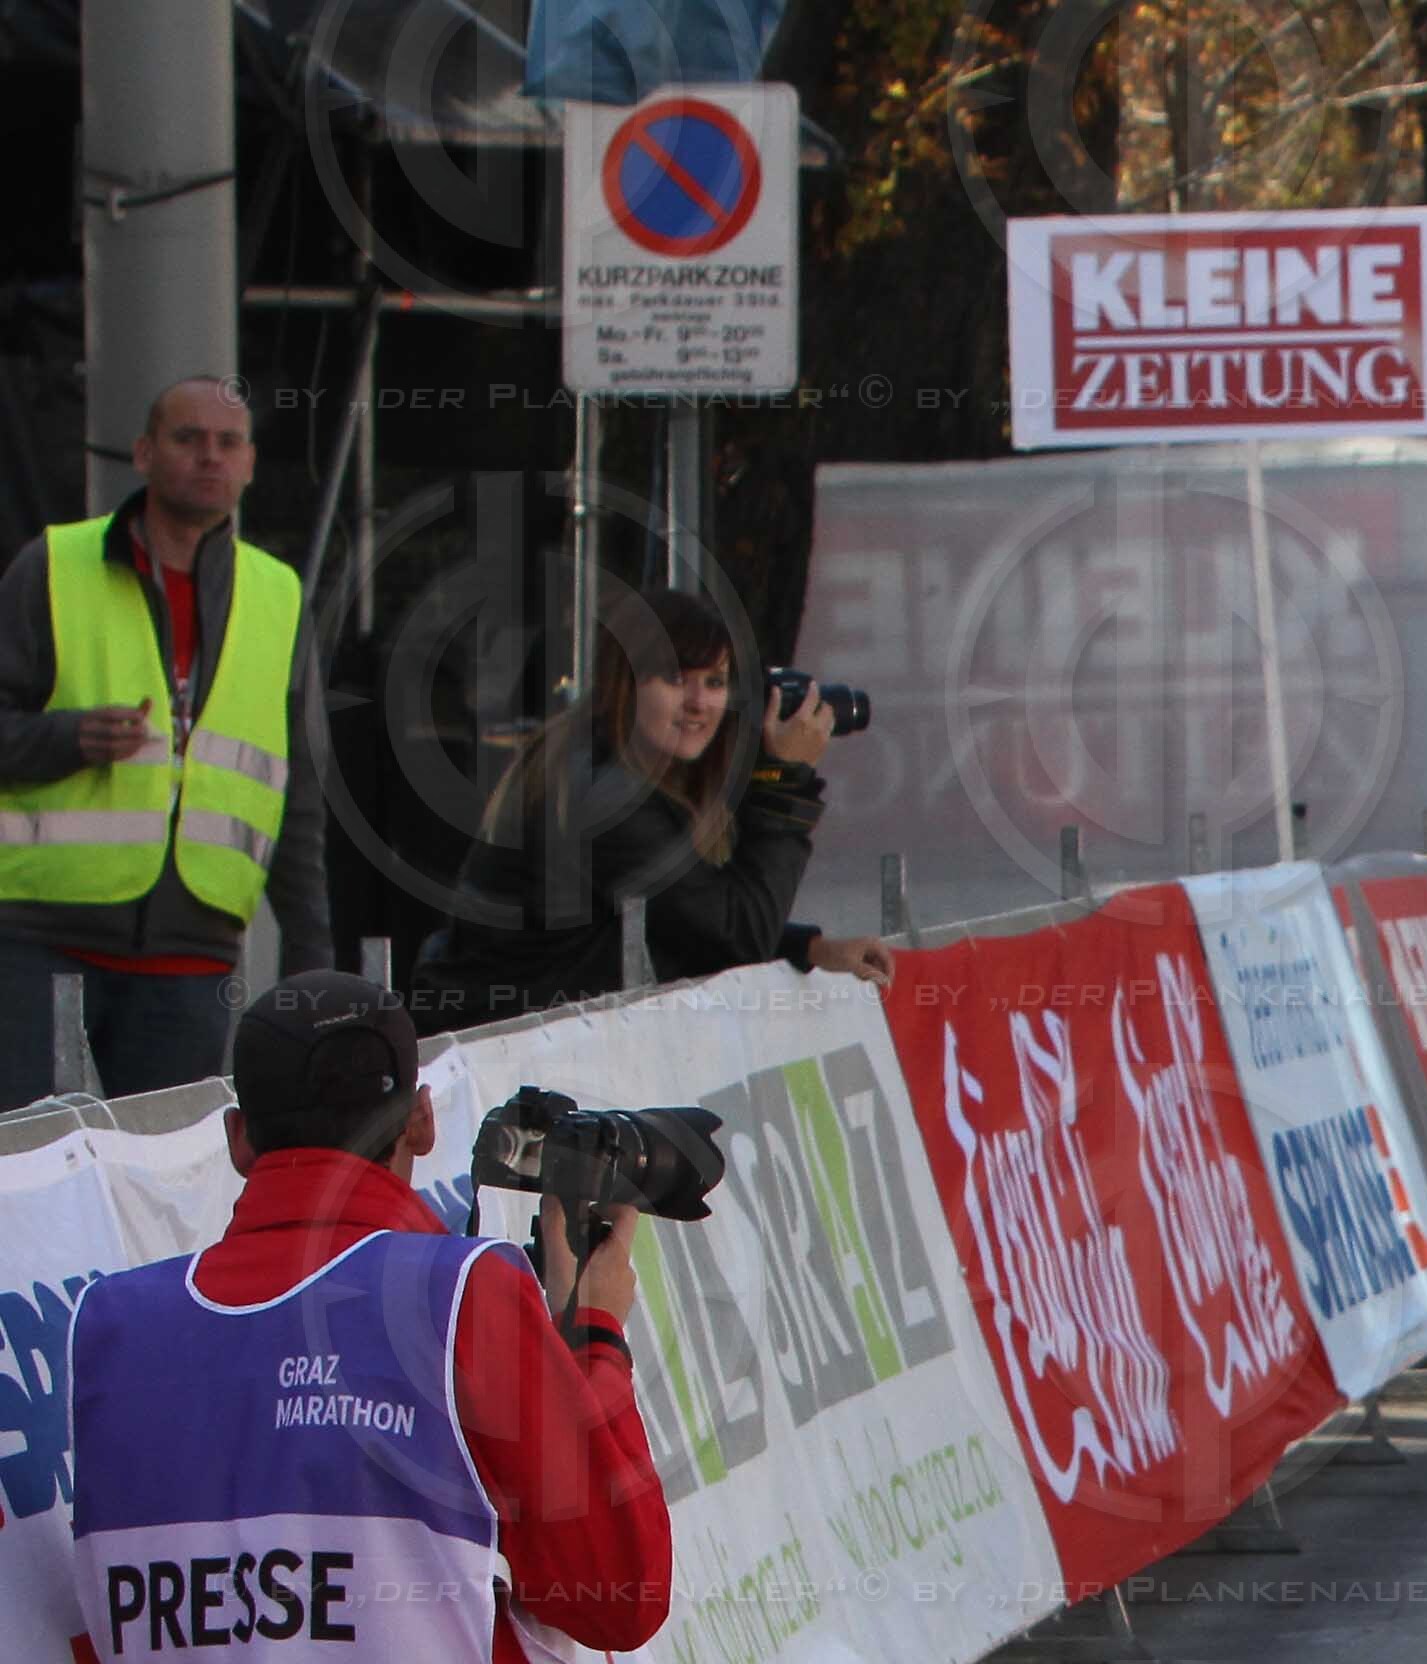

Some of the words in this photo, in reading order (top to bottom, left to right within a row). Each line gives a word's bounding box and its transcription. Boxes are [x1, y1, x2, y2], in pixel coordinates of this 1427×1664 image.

[578, 265, 784, 287] KURZPARKZONE
[1072, 244, 1404, 331] KLEINE
[1072, 345, 1410, 412] ZEITUNG
[278, 1353, 341, 1388] GRAZ
[274, 1396, 416, 1439] MARATHON
[107, 1549, 357, 1657] PRESSE
